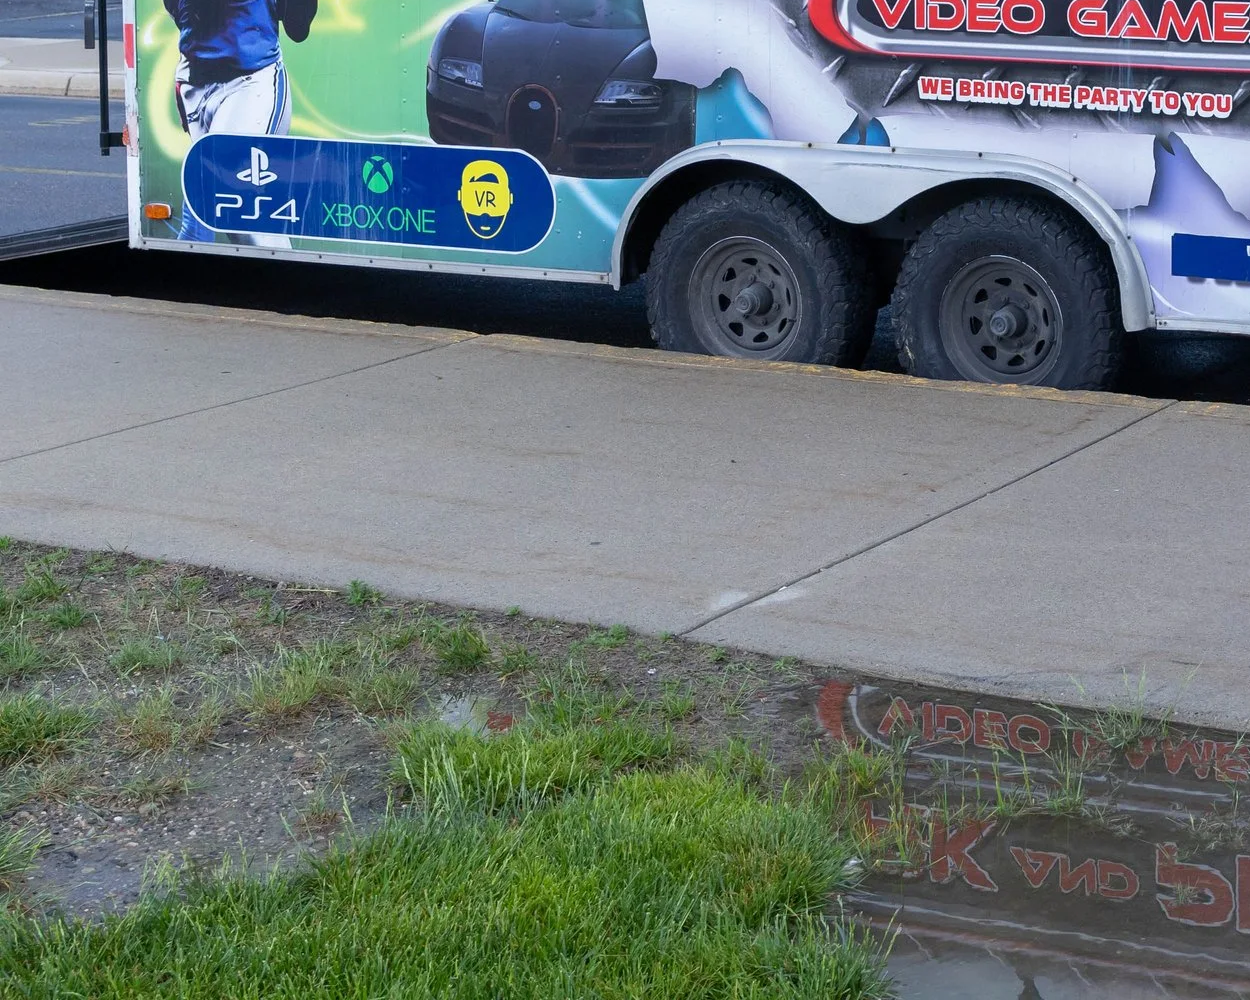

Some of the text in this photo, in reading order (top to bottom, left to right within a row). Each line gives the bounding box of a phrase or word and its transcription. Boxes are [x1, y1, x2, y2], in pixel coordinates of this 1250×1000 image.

[919, 76, 1233, 116] WE BRING THE PARTY TO YOU
[214, 192, 301, 223] PS4
[474, 189, 497, 208] VR
[321, 202, 436, 234] XBOX ONE
